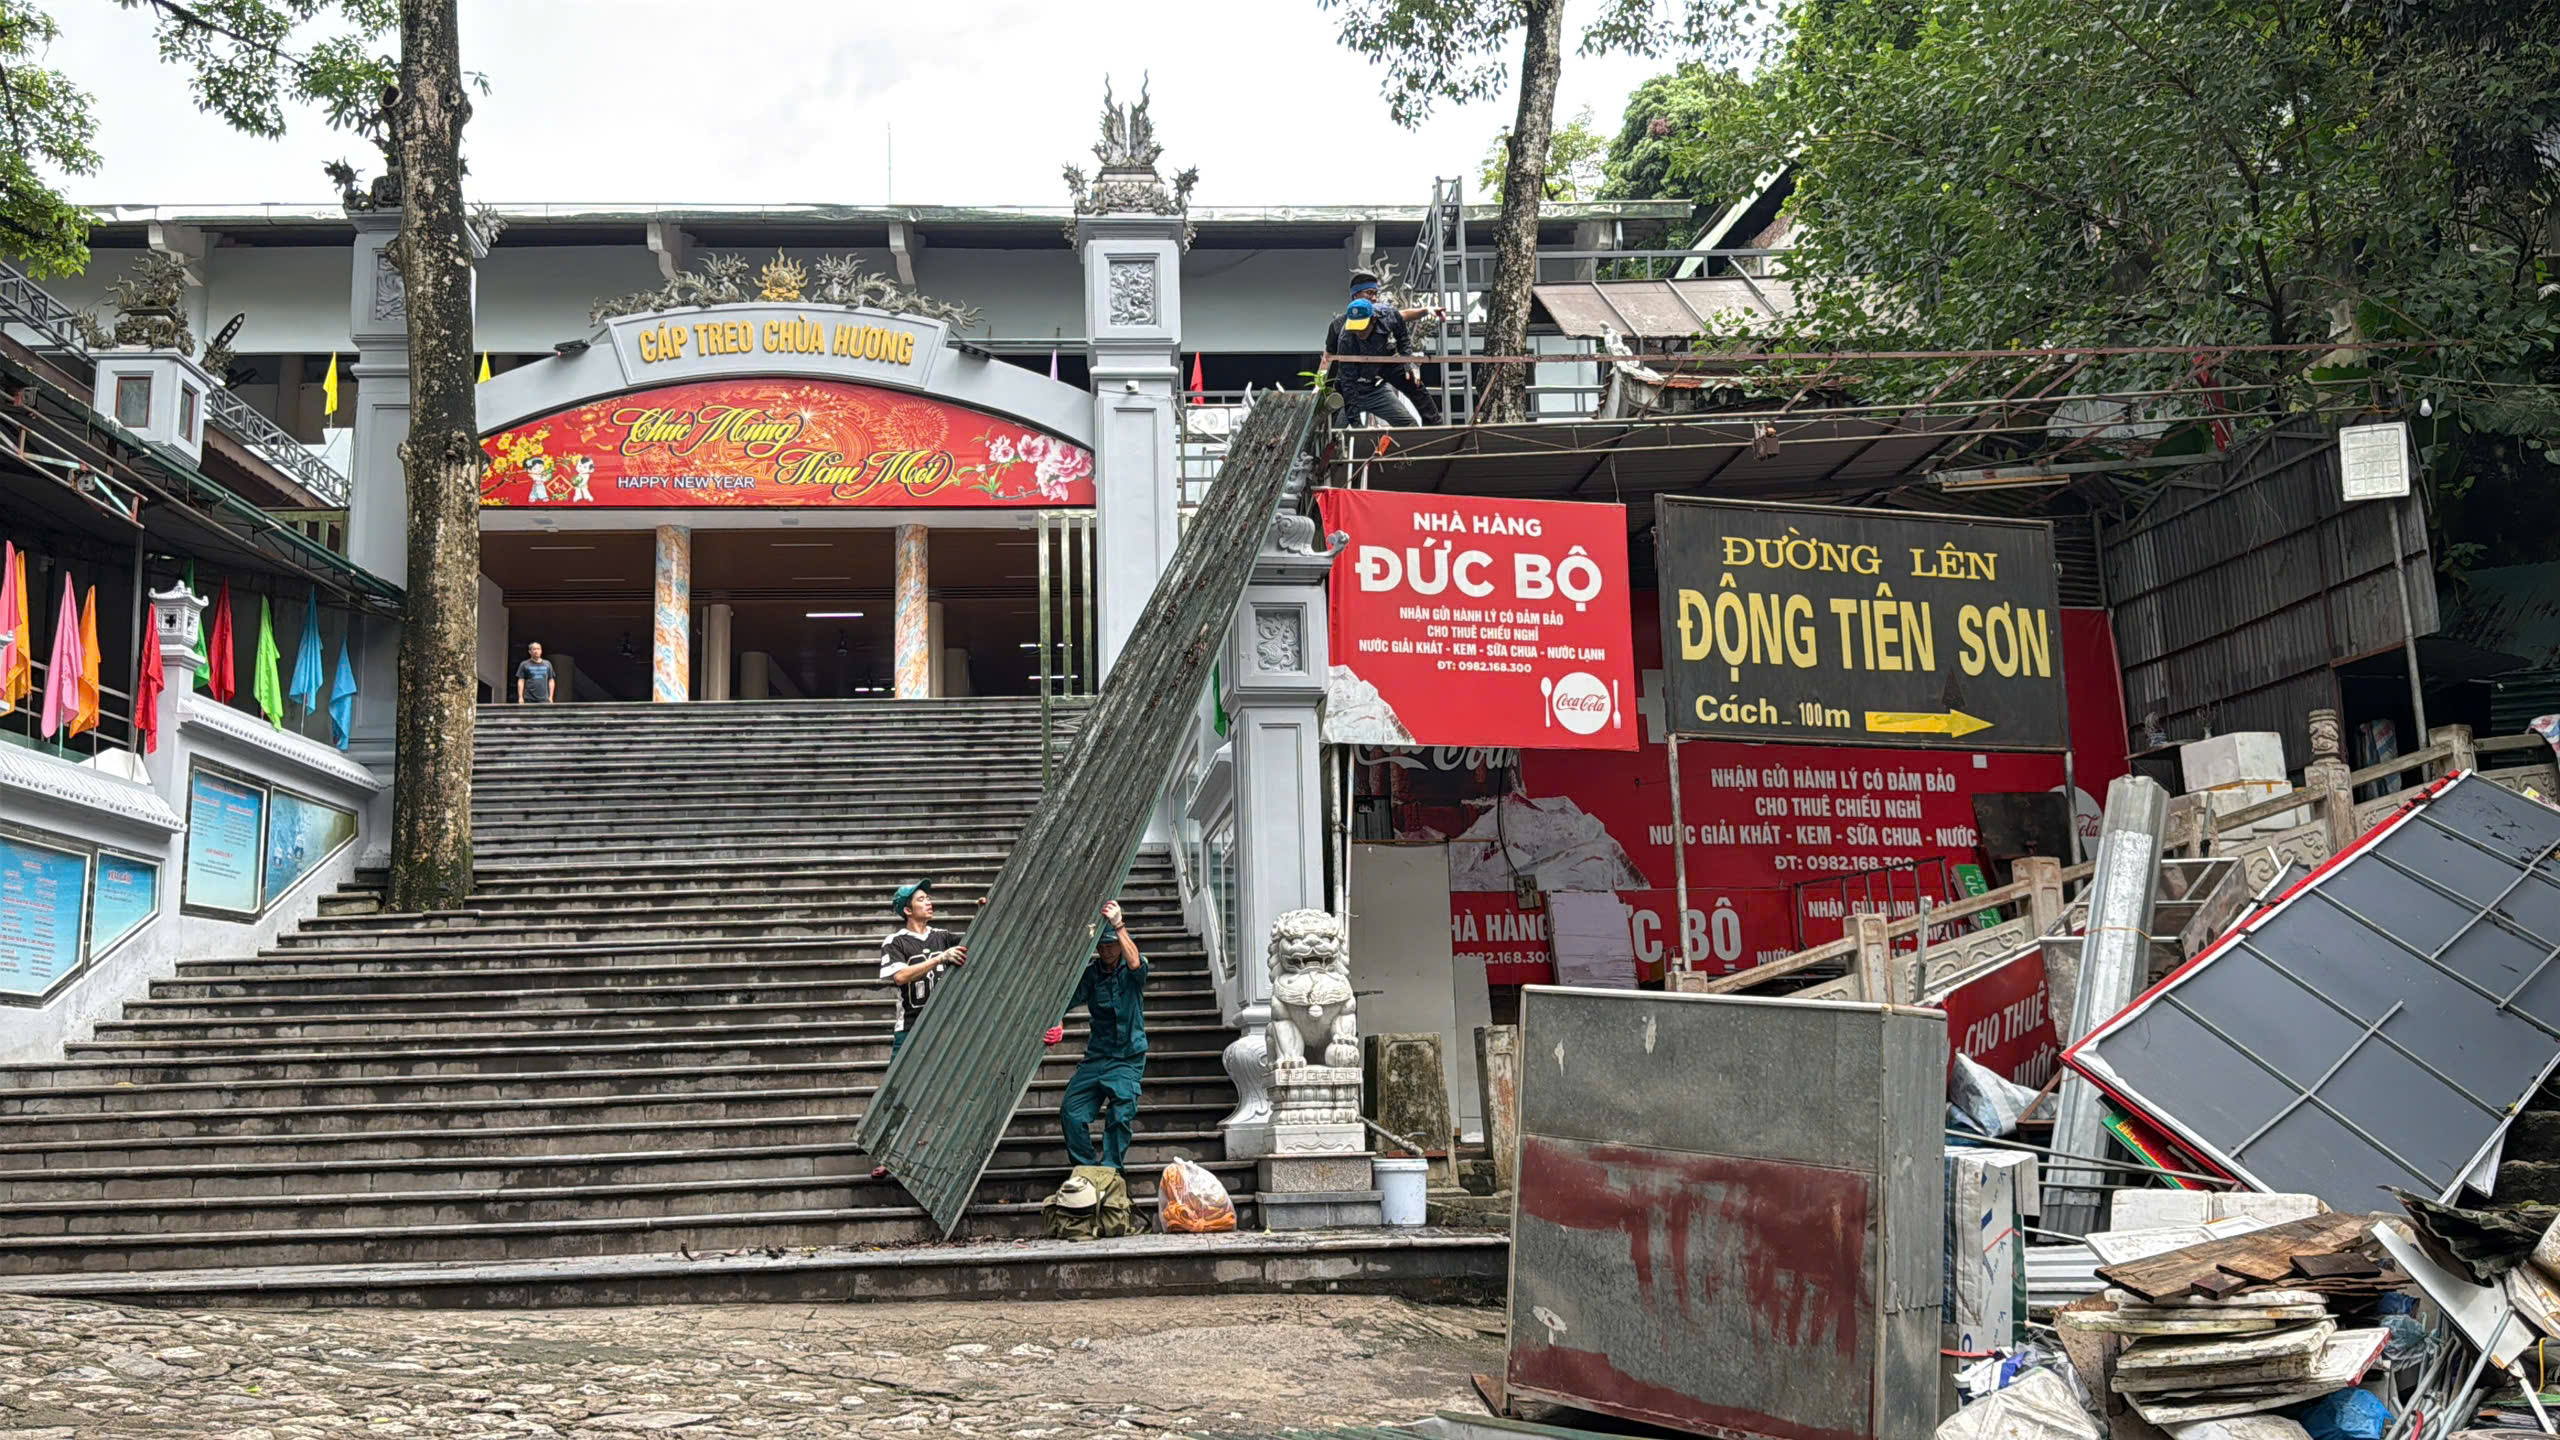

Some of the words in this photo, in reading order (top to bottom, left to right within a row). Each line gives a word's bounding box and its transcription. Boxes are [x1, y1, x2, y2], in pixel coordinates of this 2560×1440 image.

[639, 320, 688, 363] CÁP
[694, 320, 755, 356] TREO
[762, 314, 826, 354] CHÙA
[831, 323, 916, 365] HƯƠNG
[611, 407, 697, 456] Chúc
[618, 477, 669, 489] HAPPY
[674, 477, 711, 489] NEW
[711, 477, 755, 489] YEAR
[775, 449, 868, 486] Năm
[832, 449, 957, 500] Mới
[1413, 510, 1467, 533] NHÀ
[1473, 512, 1542, 537] HÀNG
[1721, 526, 1883, 575] ĐƯỜNG
[1909, 542, 1998, 581] LÊN
[1354, 537, 1495, 598] ĐỨC
[1514, 545, 1603, 612] BỘ
[1400, 605, 1430, 622] NHẬN
[1432, 605, 1451, 621] GỬI
[1453, 607, 1482, 622] HÀNH
[1484, 608, 1497, 623] LÝ
[1499, 609, 1514, 623] CÓ
[1516, 609, 1540, 625] ĐẢM
[1543, 610, 1564, 626] BẢO
[1677, 572, 1818, 683] ĐỘNG
[1829, 582, 1936, 672] TIÊN
[1958, 601, 2052, 679] SƠN
[1427, 625, 1448, 638] CHO
[1451, 625, 1477, 639] THUÊ
[1480, 625, 1511, 640] CHIẾU
[1513, 626, 1539, 641] NGHỈ
[1359, 638, 1389, 653] NƯỚC
[1392, 637, 1413, 653] GIẢI
[1416, 640, 1443, 655] KHÁT
[1453, 643, 1477, 656] KEM
[1487, 642, 1508, 657] SỮA
[1510, 645, 1538, 658] CHUA
[1547, 645, 1576, 660] NƯỚC
[1578, 648, 1606, 663] LẠNH
[1437, 661, 1457, 671] ĐT:
[1458, 661, 1532, 673] 0982.168.300
[1556, 693, 1606, 712] Coca-Cola
[1798, 702, 1851, 729] 100m
[1711, 765, 1758, 792] NHẬN
[1762, 763, 1790, 788] GỬI
[1793, 767, 1837, 790] HÀNH
[1840, 768, 1857, 790] LÝ
[1862, 768, 1883, 791] CÓ
[1887, 766, 1923, 792] ĐẢM
[1926, 767, 1956, 793] BẢO
[1755, 797, 1788, 816] CHO
[1791, 794, 1832, 817] THUÊ
[1835, 793, 1881, 818] CHIẾU
[1885, 794, 1922, 819] NGHỈ
[1649, 824, 1696, 845] NƯC
[1701, 819, 1736, 845] GIẢI
[1739, 821, 1781, 845] KHÁT
[1796, 826, 1832, 845] KEM
[1847, 823, 1879, 846] SỮA
[1882, 827, 1923, 847] CHUA
[1936, 825, 1977, 847] NƯỚC
[1774, 856, 1803, 870] ĐT:
[1807, 856, 1914, 872] 0982.168.300
[1965, 1012, 2000, 1059] CHO
[2003, 980, 2046, 1043] THUÊ
